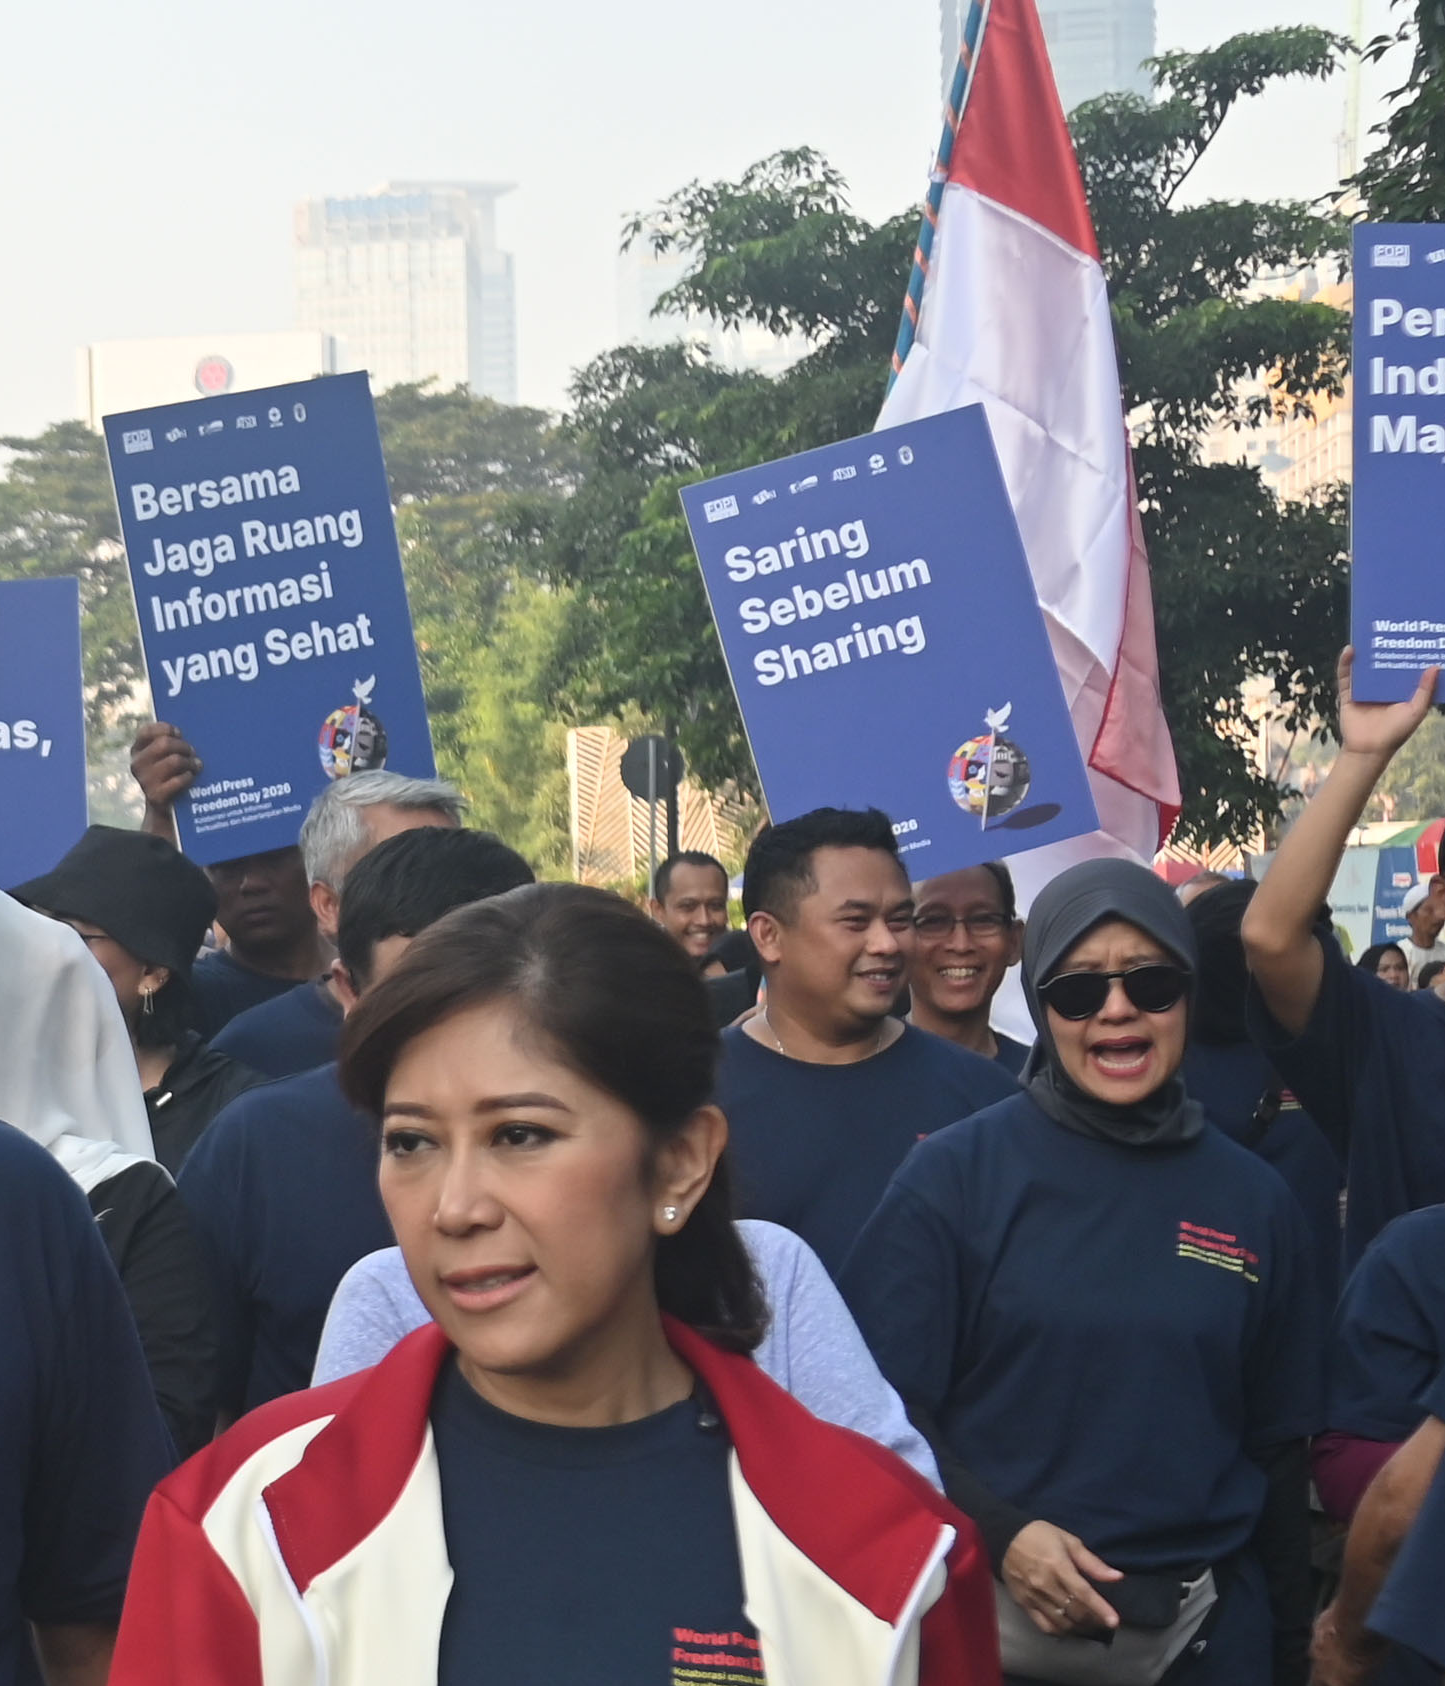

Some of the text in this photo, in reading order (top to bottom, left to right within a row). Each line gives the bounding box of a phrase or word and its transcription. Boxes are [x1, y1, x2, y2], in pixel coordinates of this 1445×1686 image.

[131, 465, 300, 521] Bersama
[143, 508, 364, 577] Jaga Ruang
[724, 519, 870, 582] Saring
[151, 560, 334, 632] Informasi
[739, 558, 932, 634] Sebelum
[1372, 620, 1418, 632] World
[1372, 636, 1436, 649] Freedom
[161, 613, 375, 697] yang Sehat
[753, 615, 926, 687] Sharing
[189, 777, 254, 799] World Press
[191, 796, 240, 814] Freedom
[239, 791, 262, 805] Day
[891, 818, 919, 836] 026
[673, 1626, 729, 1646] World
[672, 1647, 752, 1669] Freedom
